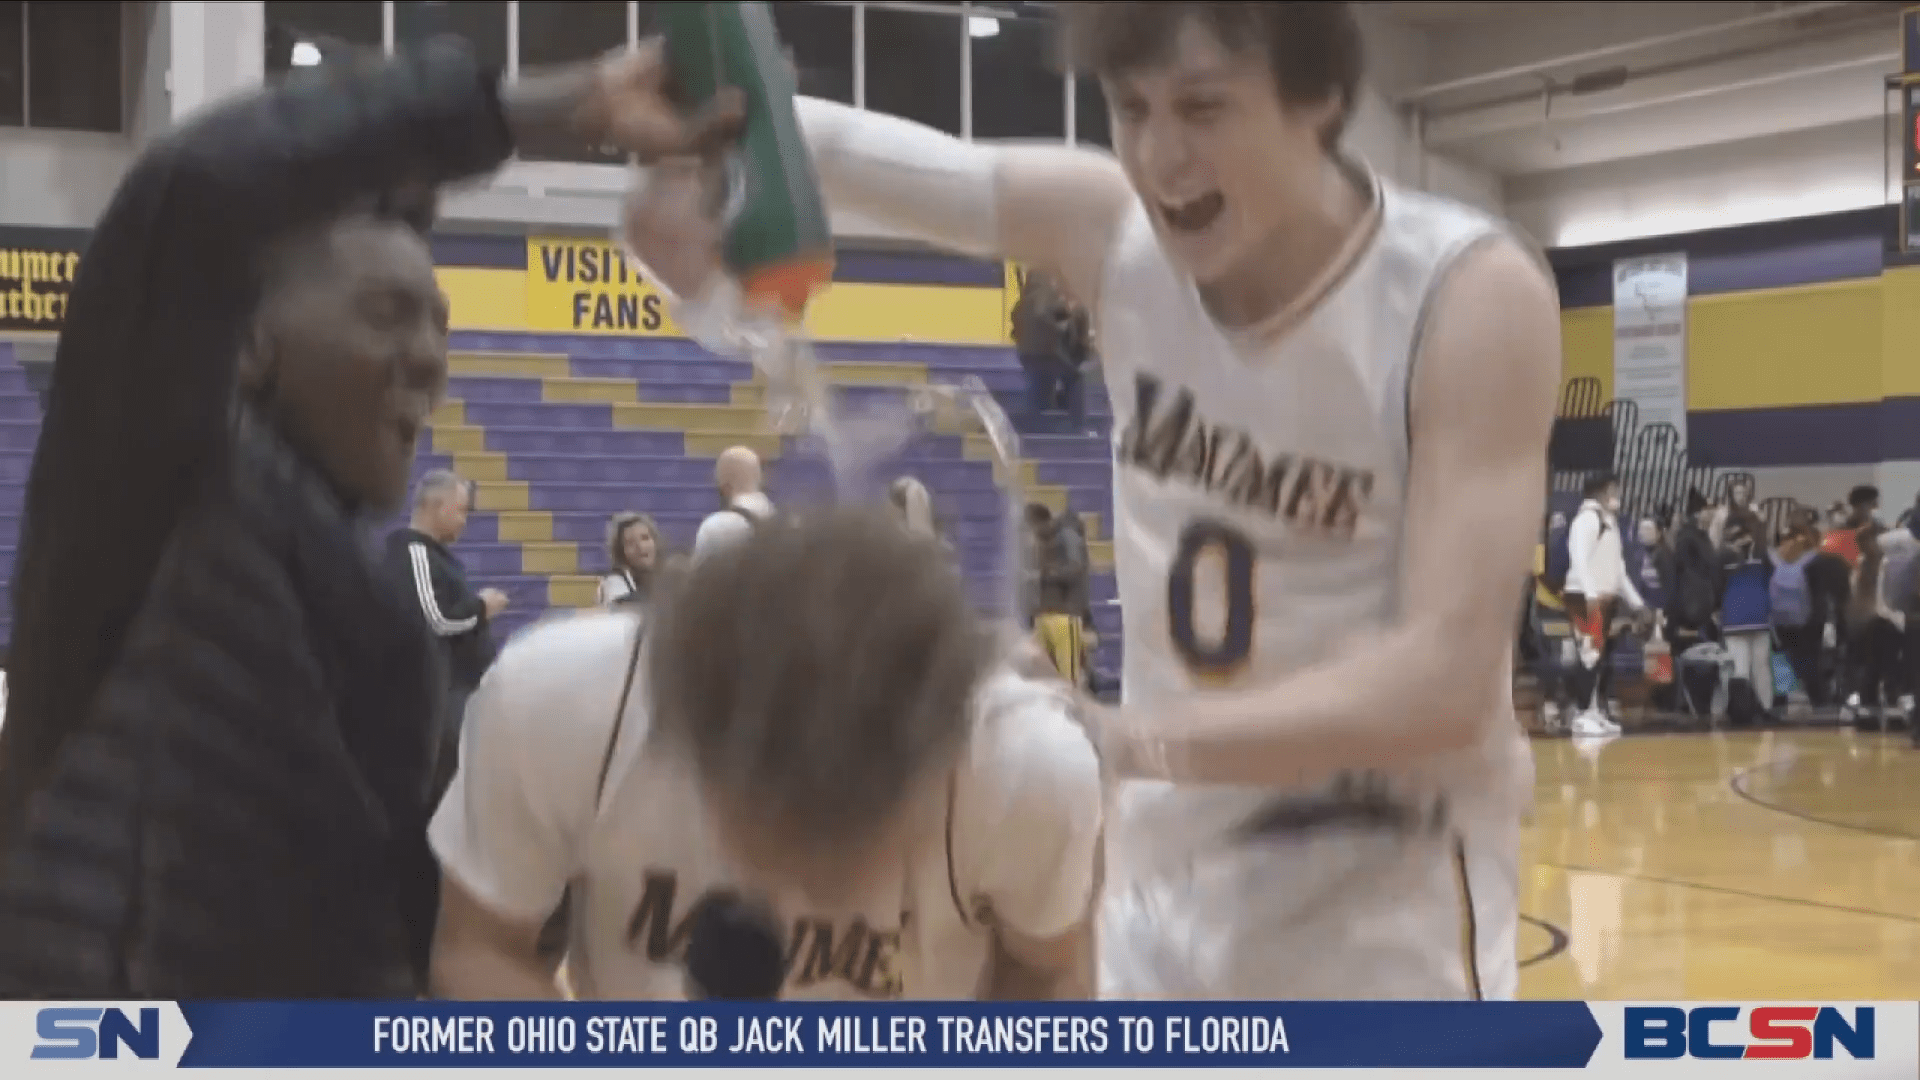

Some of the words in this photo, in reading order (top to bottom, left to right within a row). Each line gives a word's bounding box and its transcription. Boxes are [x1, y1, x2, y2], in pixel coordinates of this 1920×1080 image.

[540, 245, 643, 284] VISIT
[572, 292, 662, 330] FANS
[1120, 369, 1375, 538] MAUMEE
[1167, 514, 1256, 682] 0
